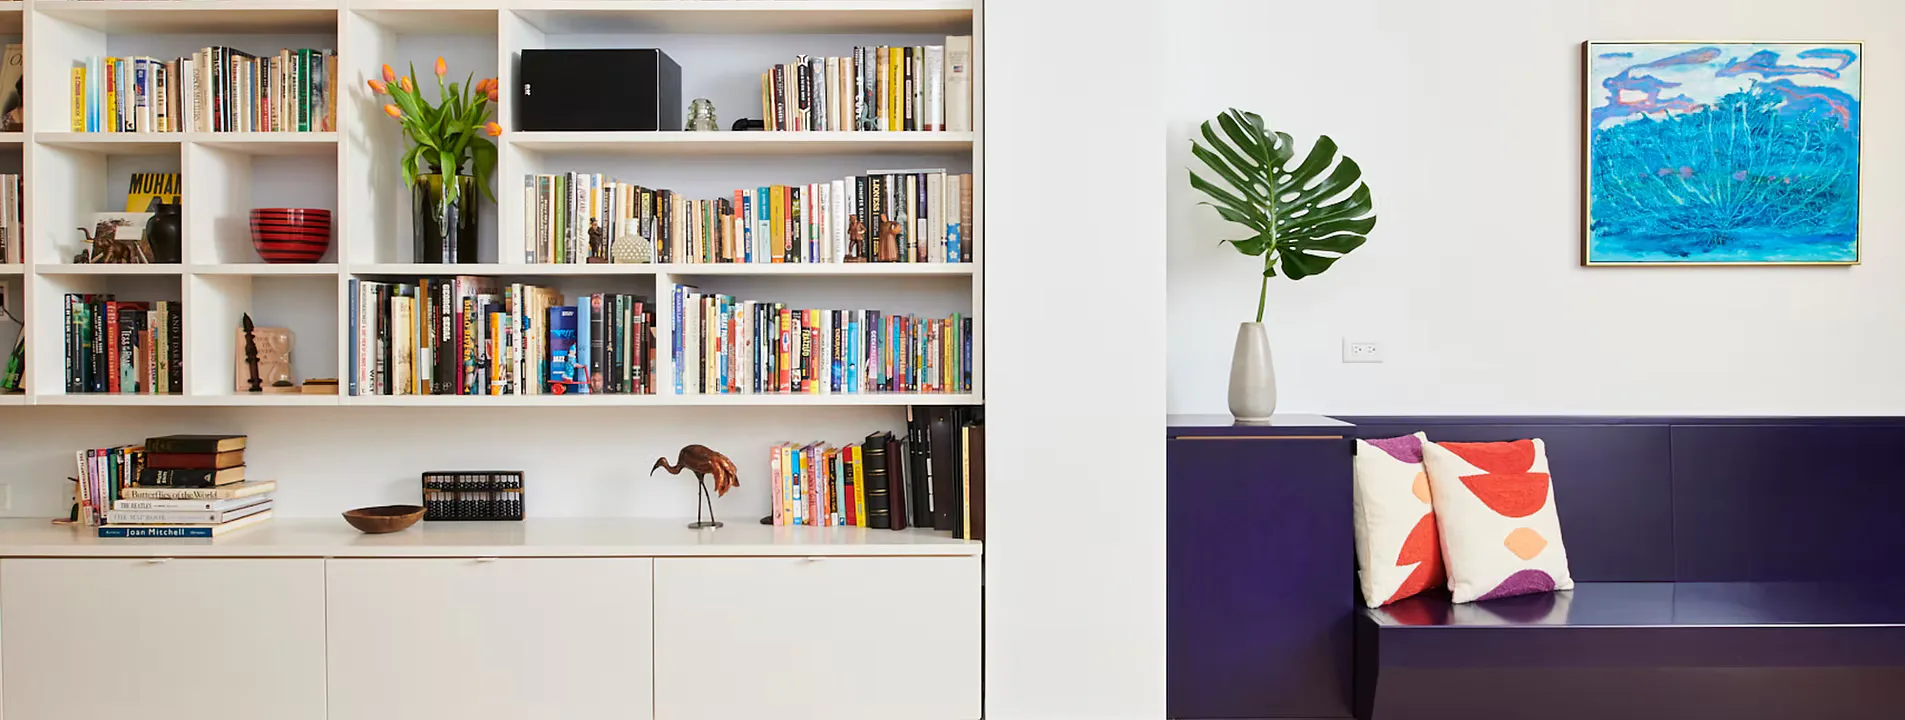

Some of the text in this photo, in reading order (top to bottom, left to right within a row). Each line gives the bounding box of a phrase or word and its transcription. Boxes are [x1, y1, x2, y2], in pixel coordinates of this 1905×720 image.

[872, 179, 880, 212] LIONESS
[131, 489, 217, 499] Butterflies of the World
[126, 529, 146, 537] Joan
[147, 528, 185, 536] Mitchell
